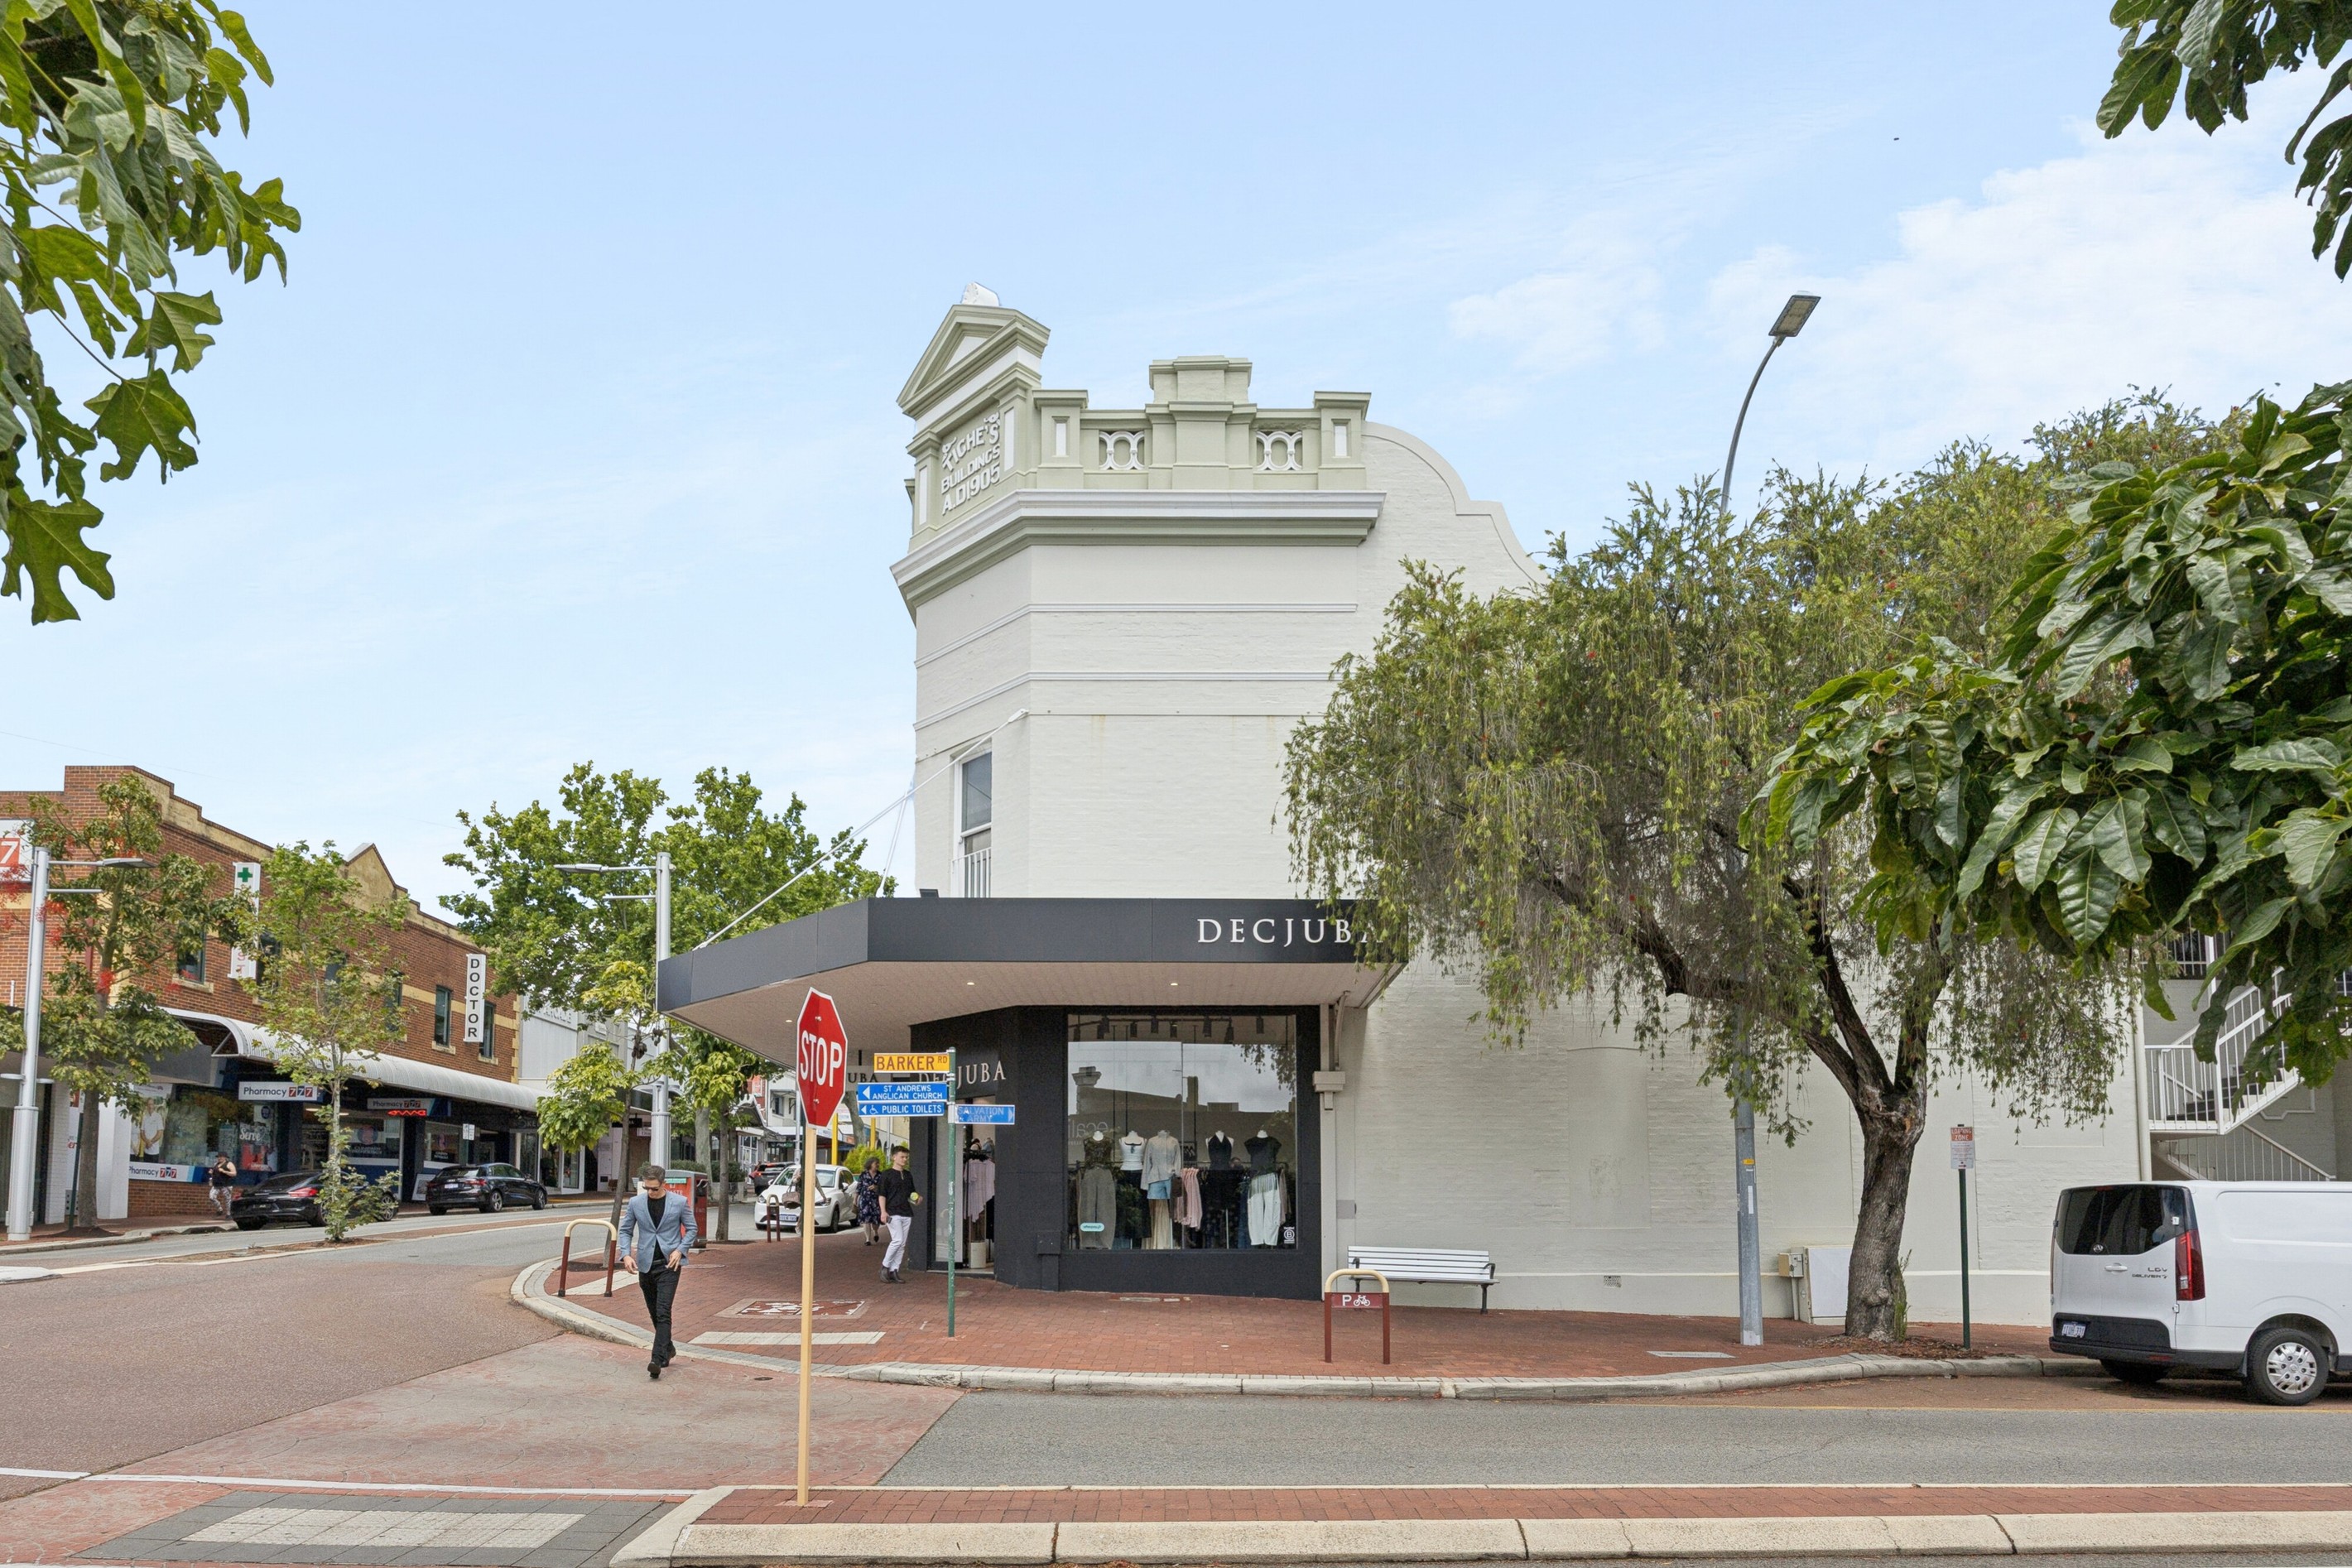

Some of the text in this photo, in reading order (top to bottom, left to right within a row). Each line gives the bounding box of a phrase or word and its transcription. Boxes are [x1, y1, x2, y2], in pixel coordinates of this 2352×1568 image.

[941, 444, 1000, 494] BUILDINGS
[468, 958, 480, 1037] DOCTOR
[800, 1030, 843, 1088] STOP
[877, 1056, 948, 1070] BARKER RD
[243, 1087, 313, 1097] Pharmacy 777
[373, 1100, 403, 1109] Pharmacy
[882, 1105, 942, 1113] PUBLIC TOILETS
[959, 1106, 1004, 1115] SALVATION
[160, 1167, 176, 1178] 777
[1342, 1295, 1352, 1306] P
